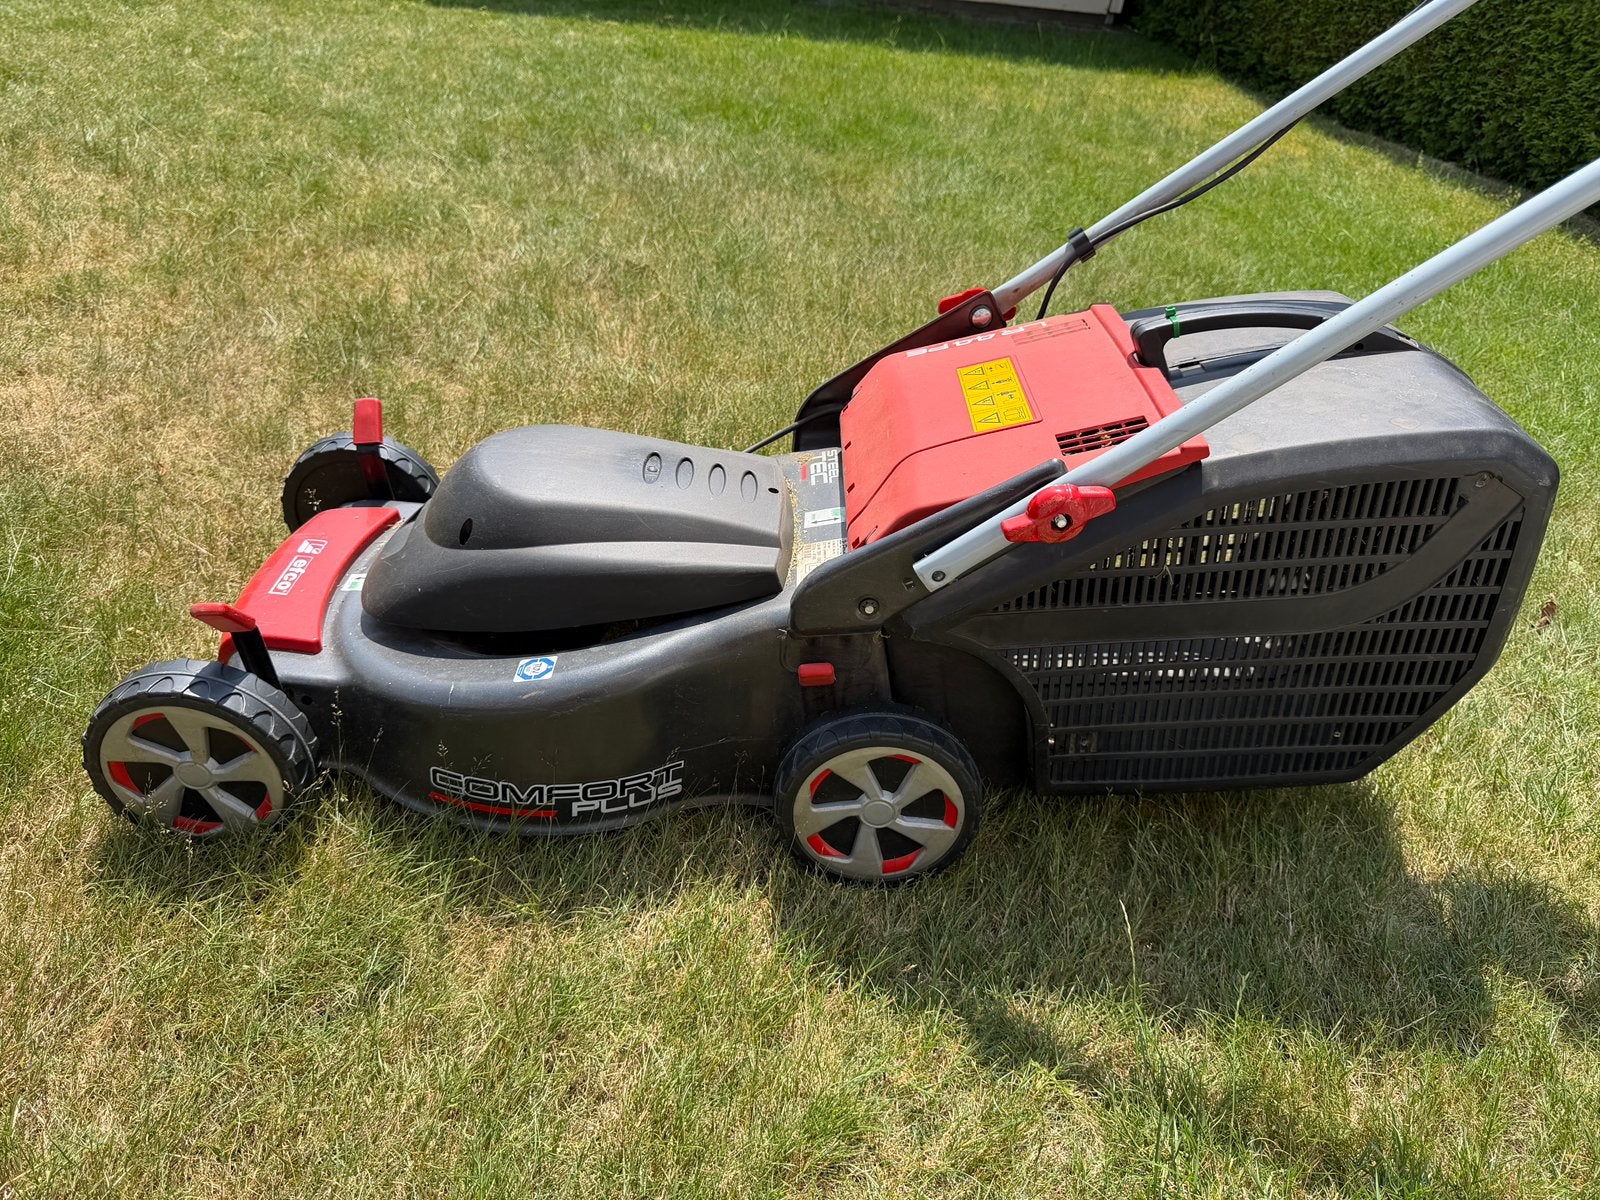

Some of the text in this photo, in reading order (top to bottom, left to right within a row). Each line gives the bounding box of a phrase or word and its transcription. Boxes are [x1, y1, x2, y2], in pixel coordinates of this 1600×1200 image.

[1001, 321, 1048, 336] LR
[810, 451, 829, 485] TEC
[826, 450, 839, 483] STEEL
[430, 760, 684, 805] COMFORT
[571, 778, 683, 817] PLUS
